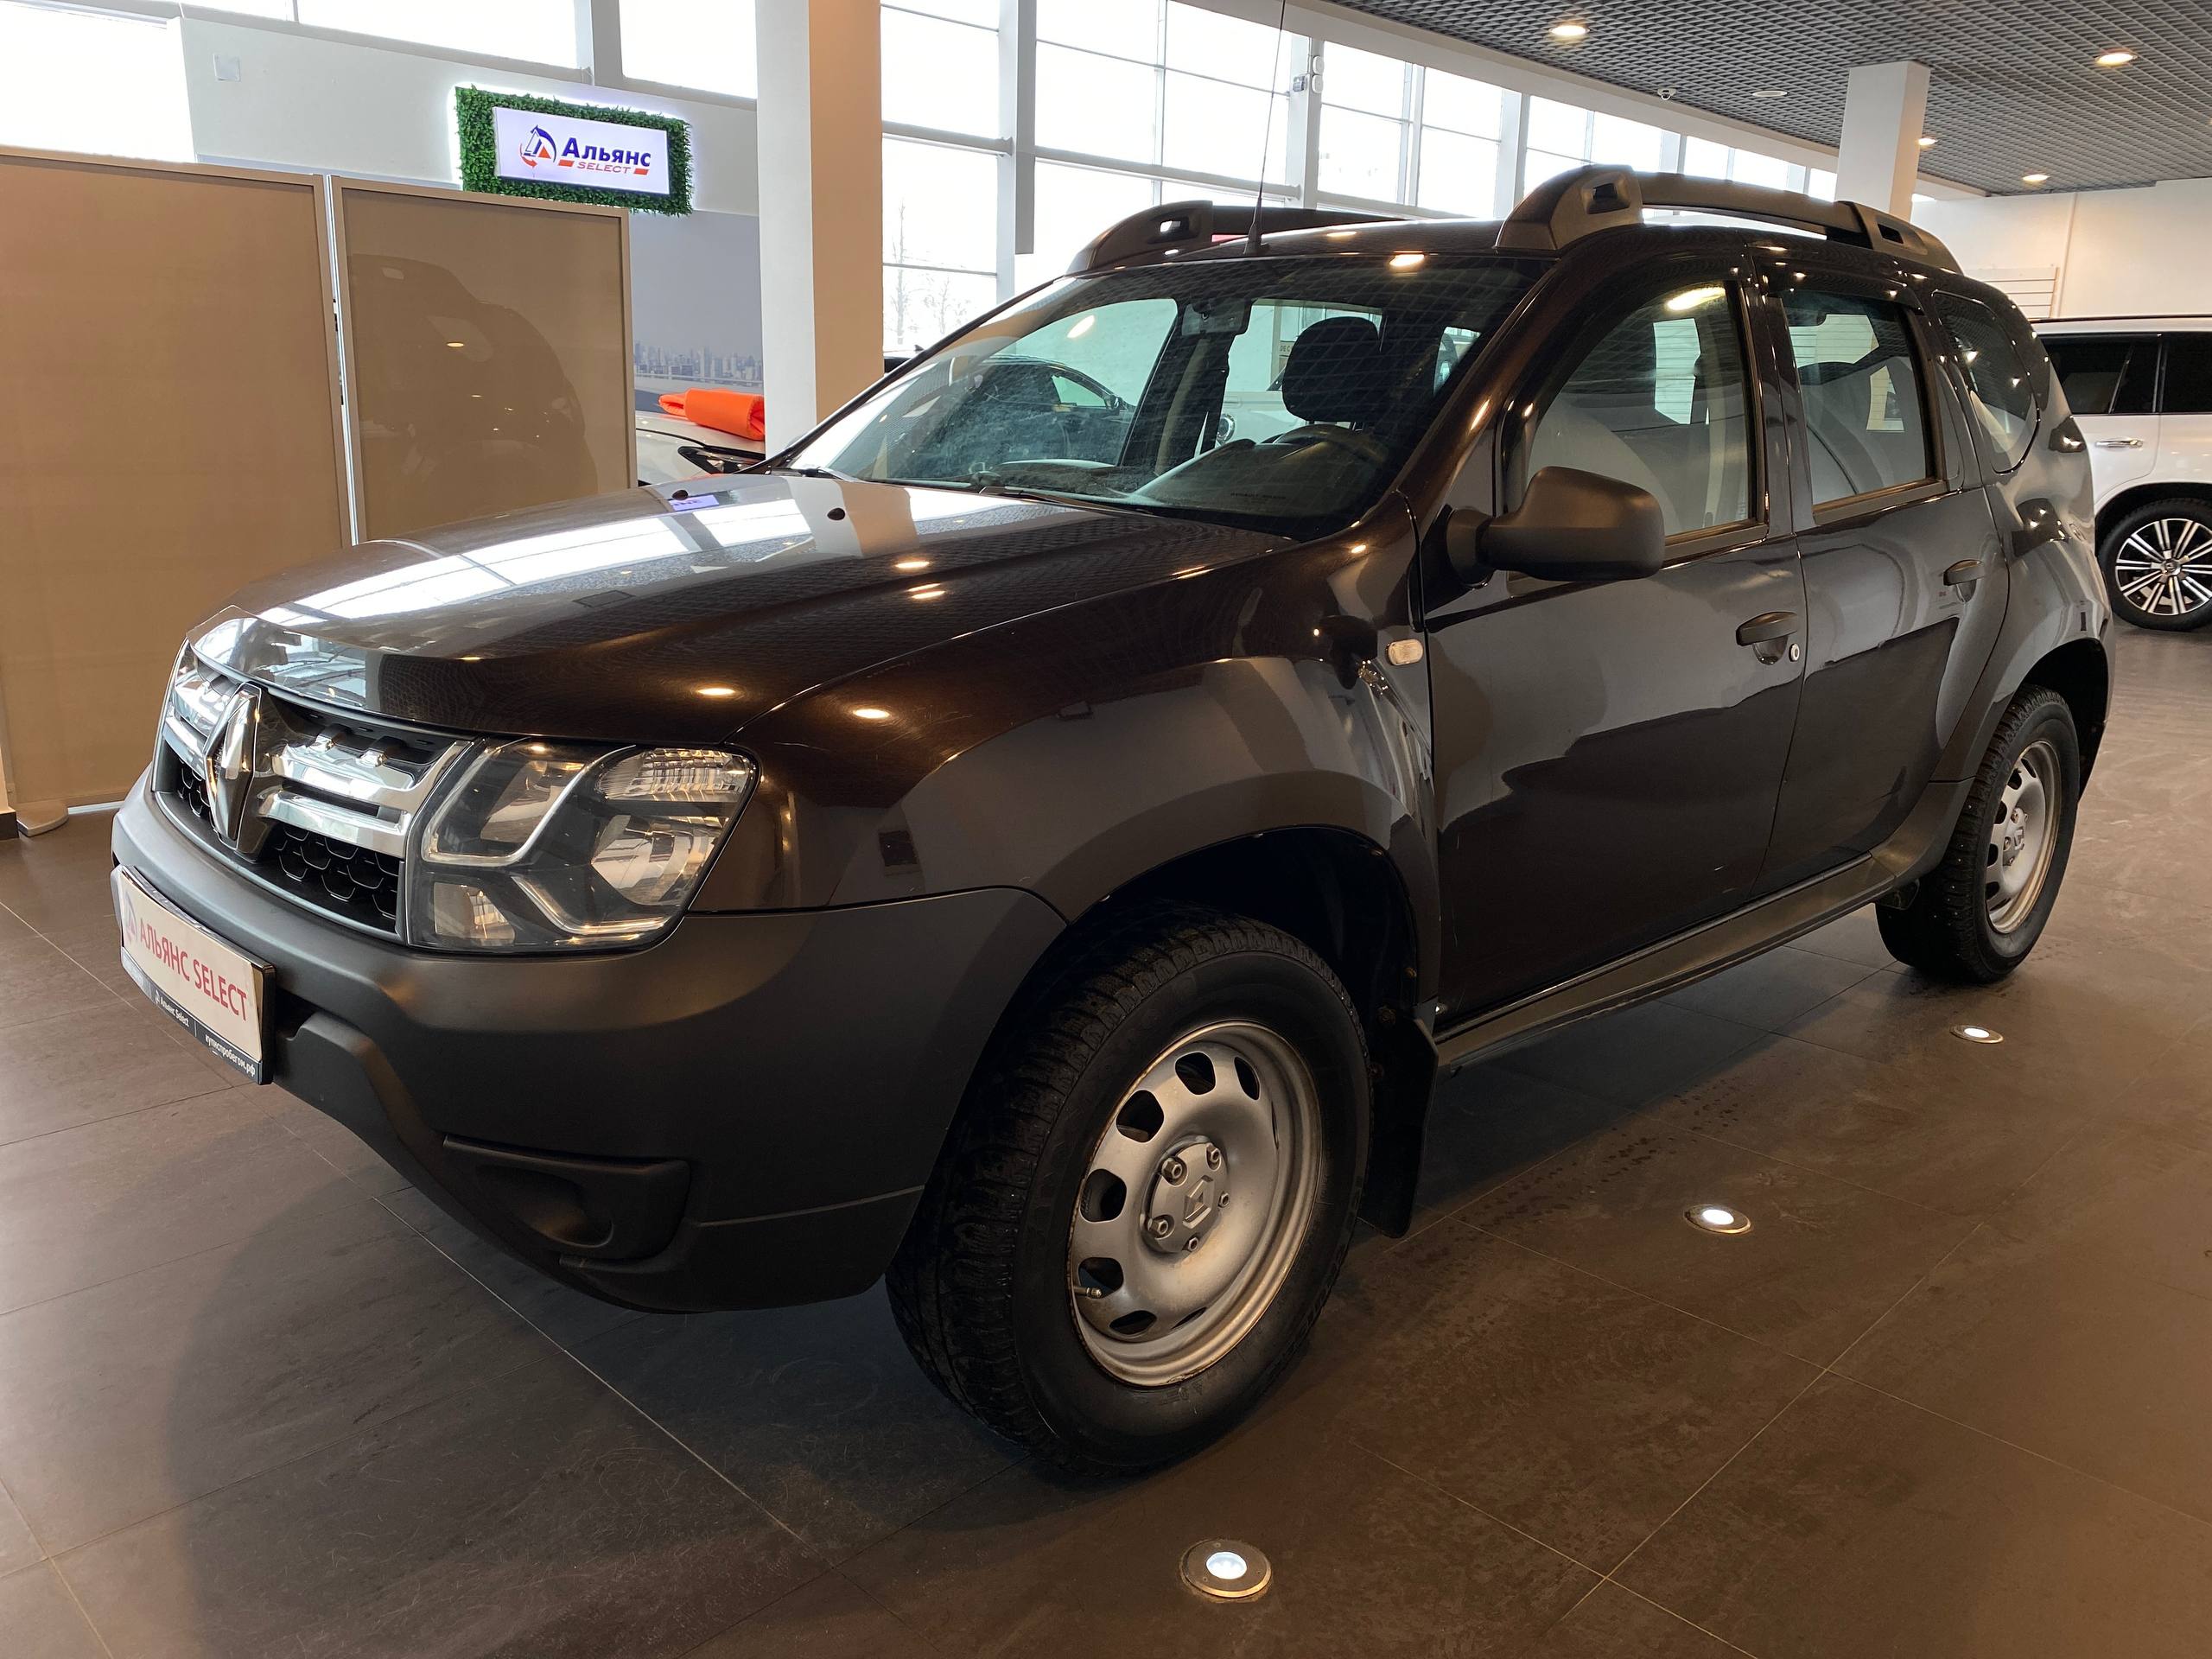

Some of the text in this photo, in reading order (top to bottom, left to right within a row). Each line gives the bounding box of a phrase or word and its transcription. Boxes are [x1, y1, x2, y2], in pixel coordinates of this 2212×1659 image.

[561, 137, 652, 167] Альянс
[576, 161, 632, 174] SELECT
[140, 917, 247, 1021] АЛЬЯНС SELECT
